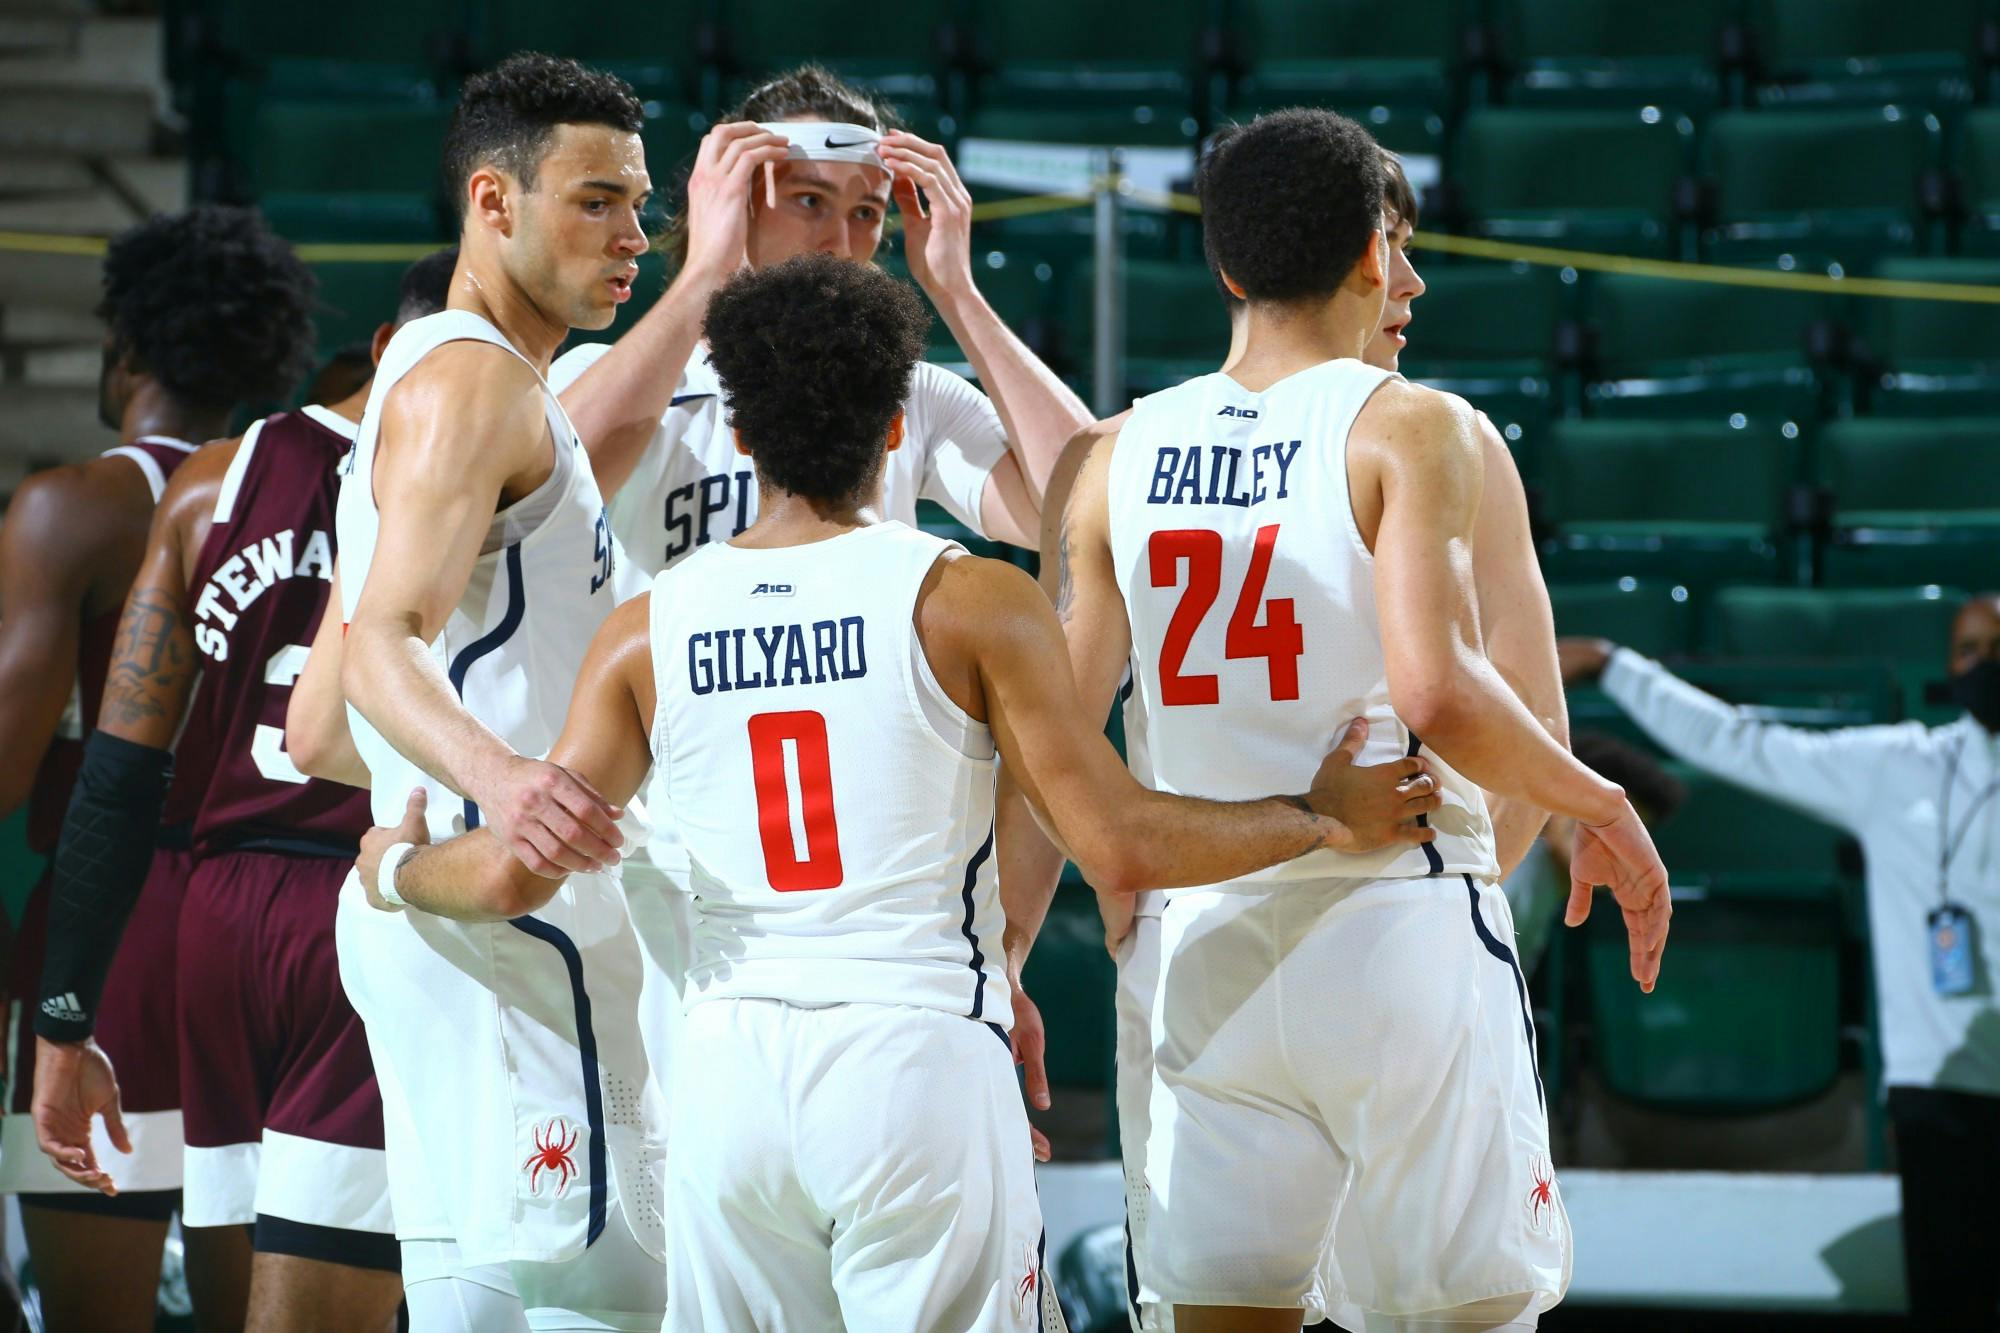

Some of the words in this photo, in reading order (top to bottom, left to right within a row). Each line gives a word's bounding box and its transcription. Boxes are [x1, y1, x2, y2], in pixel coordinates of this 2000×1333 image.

[1217, 405, 1258, 419] A10
[1147, 440, 1302, 507] BAILEY
[750, 583, 792, 595] A10
[1148, 524, 1304, 706] 24
[688, 615, 867, 695] GILYARD
[748, 710, 844, 892] 0
